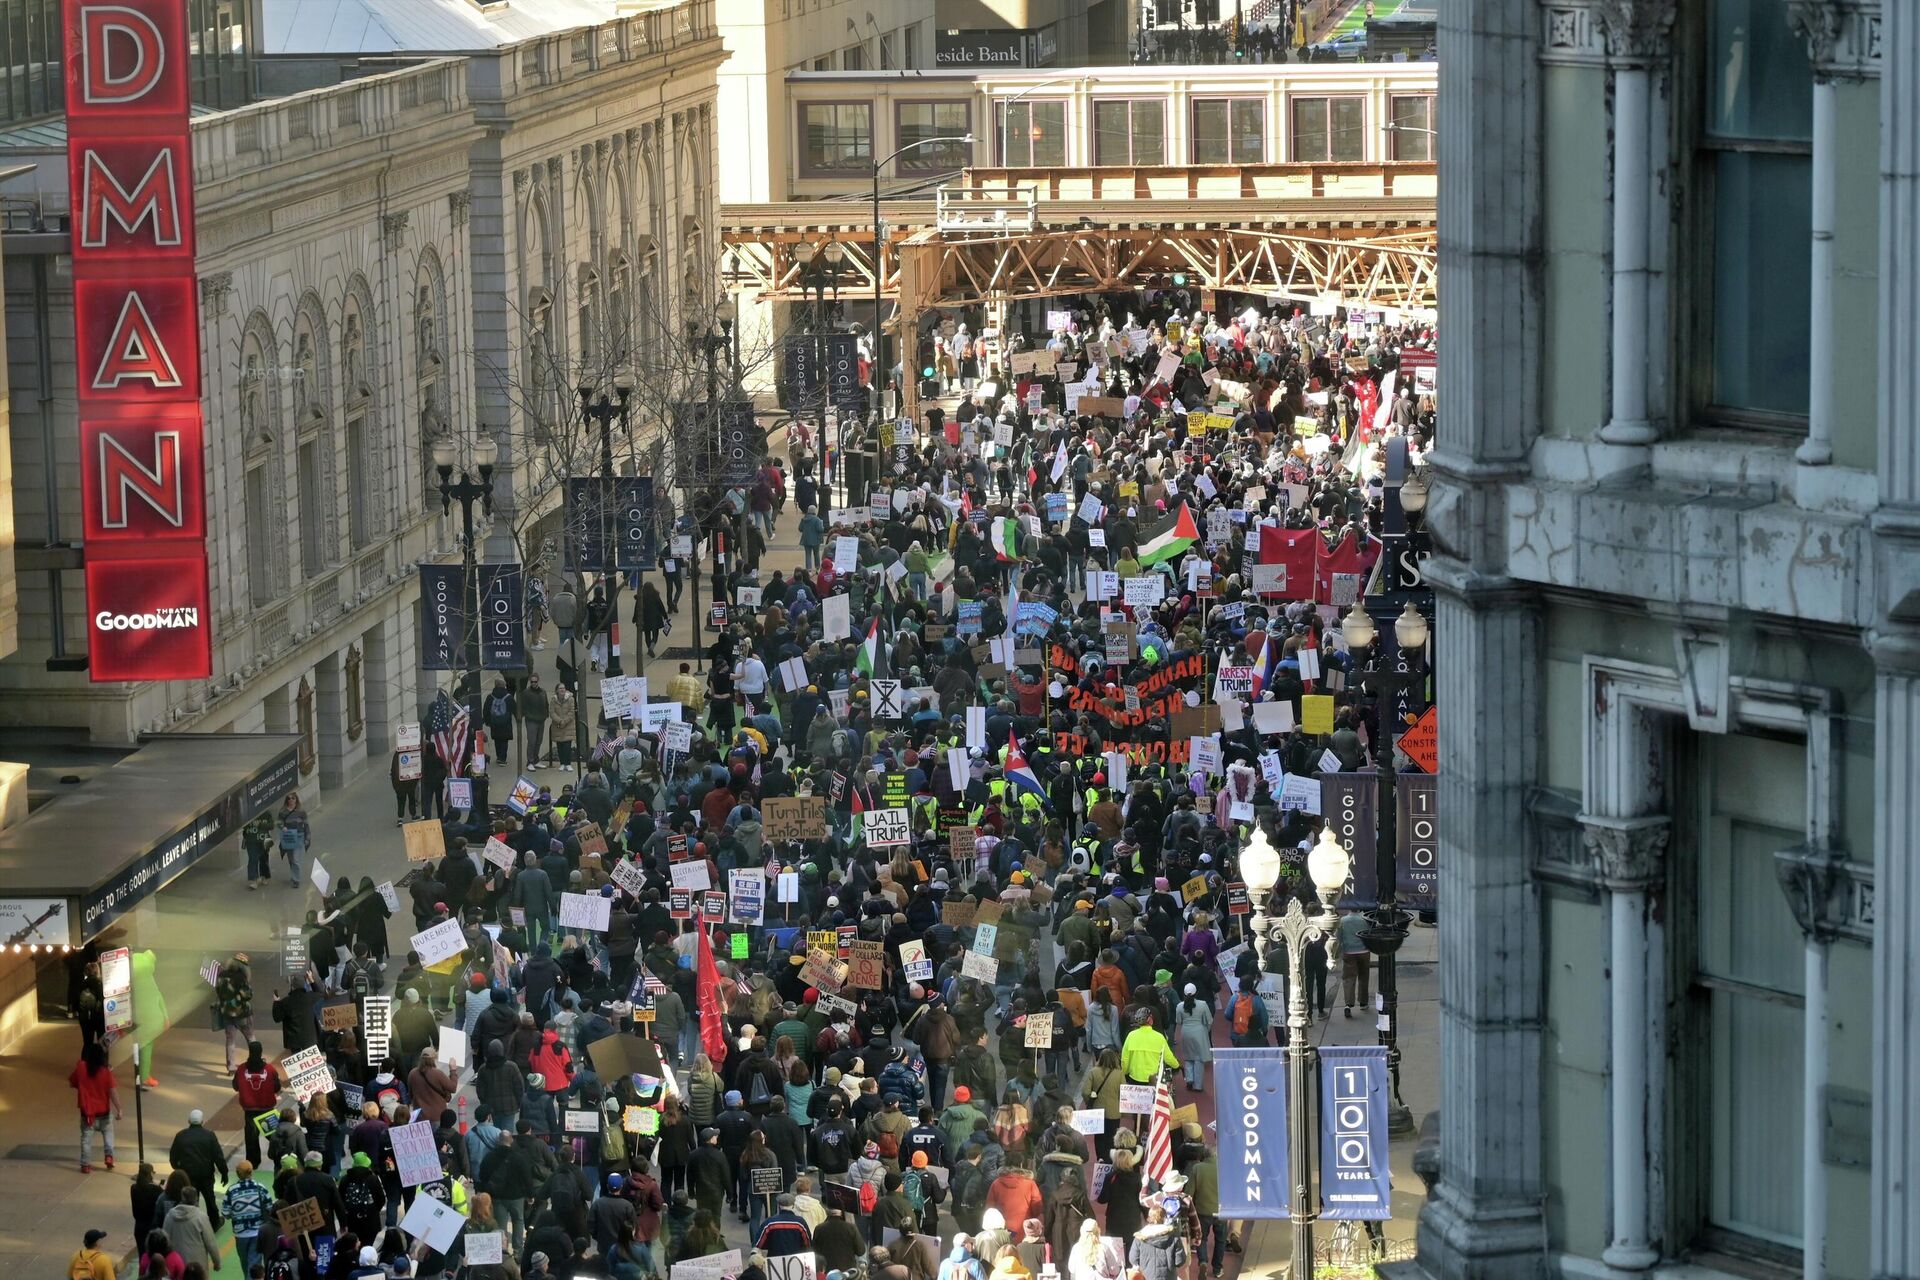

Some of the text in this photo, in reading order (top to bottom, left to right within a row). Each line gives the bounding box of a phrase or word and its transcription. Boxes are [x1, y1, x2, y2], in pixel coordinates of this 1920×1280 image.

[978, 46, 1020, 62] Bank
[629, 490, 642, 540] 100
[494, 579, 509, 635] 100
[96, 609, 198, 631] GOODMAN
[437, 581, 449, 659] GOODMAN
[1219, 667, 1251, 679] ARREST
[1221, 679, 1251, 692] TRUMP
[453, 797, 470, 807] 1776
[765, 802, 801, 820] Turn
[866, 811, 905, 827] JAIL
[578, 827, 602, 843] FUCK
[767, 822, 799, 838] Into
[868, 826, 908, 842] TRUMP
[1414, 794, 1433, 866] 100
[86, 899, 105, 923] COME
[105, 892, 114, 908] TO
[116, 884, 127, 902] THE
[162, 845, 180, 868] LEAVE
[181, 833, 197, 855] MORE
[413, 921, 458, 948] NUREMBERG
[808, 932, 827, 943] MAY
[818, 942, 836, 951] WORK
[849, 940, 878, 950] BILLIONS
[828, 957, 844, 970] NOT
[855, 951, 882, 960] DOLLARS
[809, 955, 843, 980] RED BLUE
[848, 971, 880, 987] SENSE
[819, 991, 854, 1012] WE ARE THE
[324, 1008, 335, 1017] NO
[325, 1017, 357, 1027] NO KINGS
[1028, 1021, 1052, 1029] THEM
[1025, 1037, 1048, 1045] OUT
[283, 1047, 319, 1068] RELEASE
[299, 1055, 323, 1071] FILES
[292, 1068, 328, 1089] REMOVE
[1340, 1071, 1364, 1164] 100
[392, 1121, 433, 1141] SO BAD
[912, 1134, 936, 1143] GT
[1242, 1076, 1262, 1202] GOODMAN
[1336, 1171, 1371, 1180] YEARS
[281, 1200, 317, 1221] FUCK
[290, 1212, 321, 1233] ICE
[766, 1256, 804, 1280] NO
